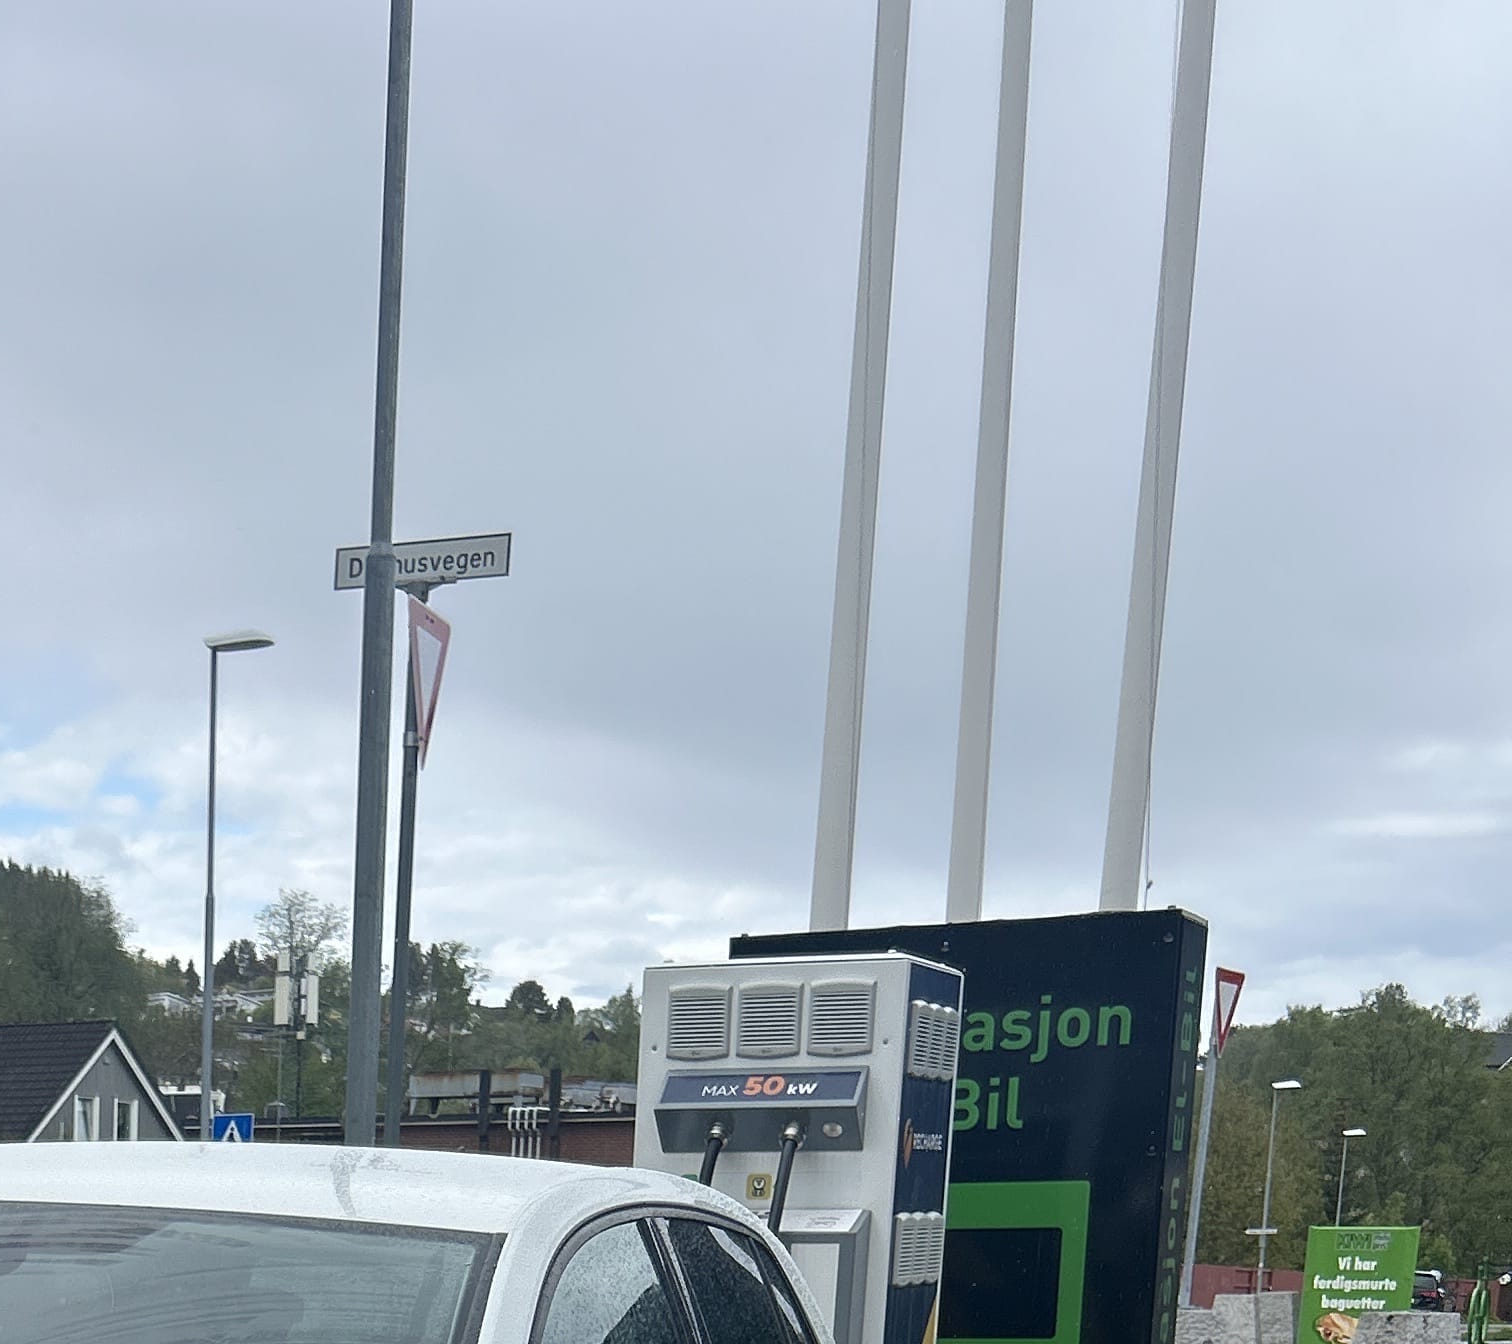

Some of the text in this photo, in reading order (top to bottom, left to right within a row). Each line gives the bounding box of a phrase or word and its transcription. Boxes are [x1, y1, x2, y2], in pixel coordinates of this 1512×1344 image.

[701, 1075, 818, 1097] MAX 50 kW
[1338, 1256, 1377, 1271] Vi har
[1313, 1275, 1397, 1293] ferdigsmurte
[1321, 1294, 1386, 1312] baguetter
